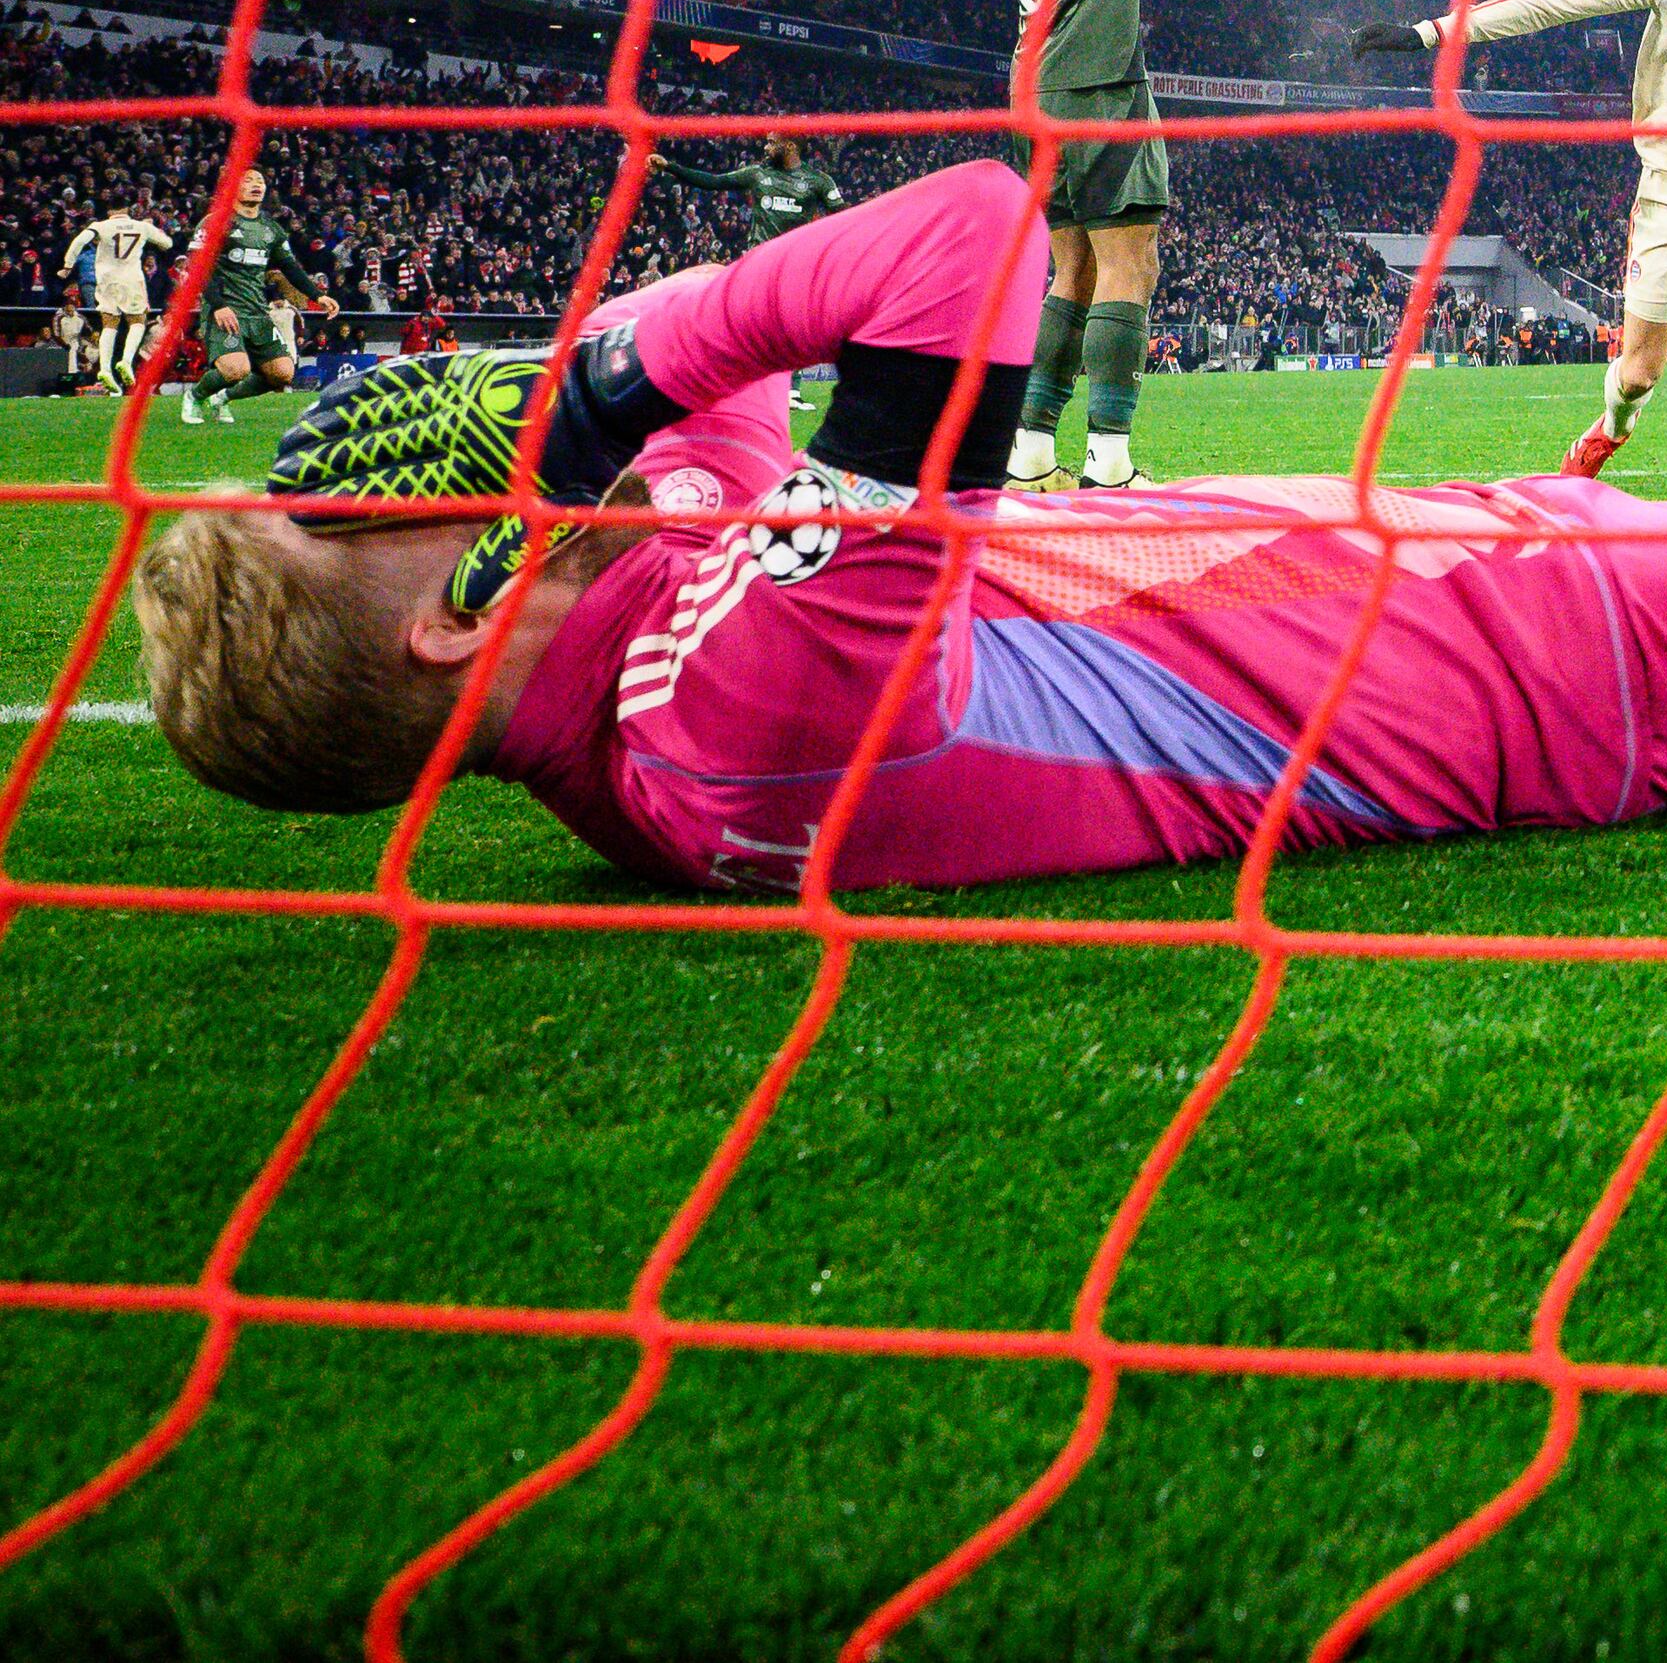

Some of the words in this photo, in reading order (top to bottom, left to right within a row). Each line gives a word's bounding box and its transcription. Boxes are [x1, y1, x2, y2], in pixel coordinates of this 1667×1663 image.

[778, 22, 809, 39] PEPSI
[1153, 76, 1175, 94] ROTE
[1177, 77, 1203, 96] PERLE
[112, 233, 142, 260] 17
[1334, 358, 1354, 370] PS5
